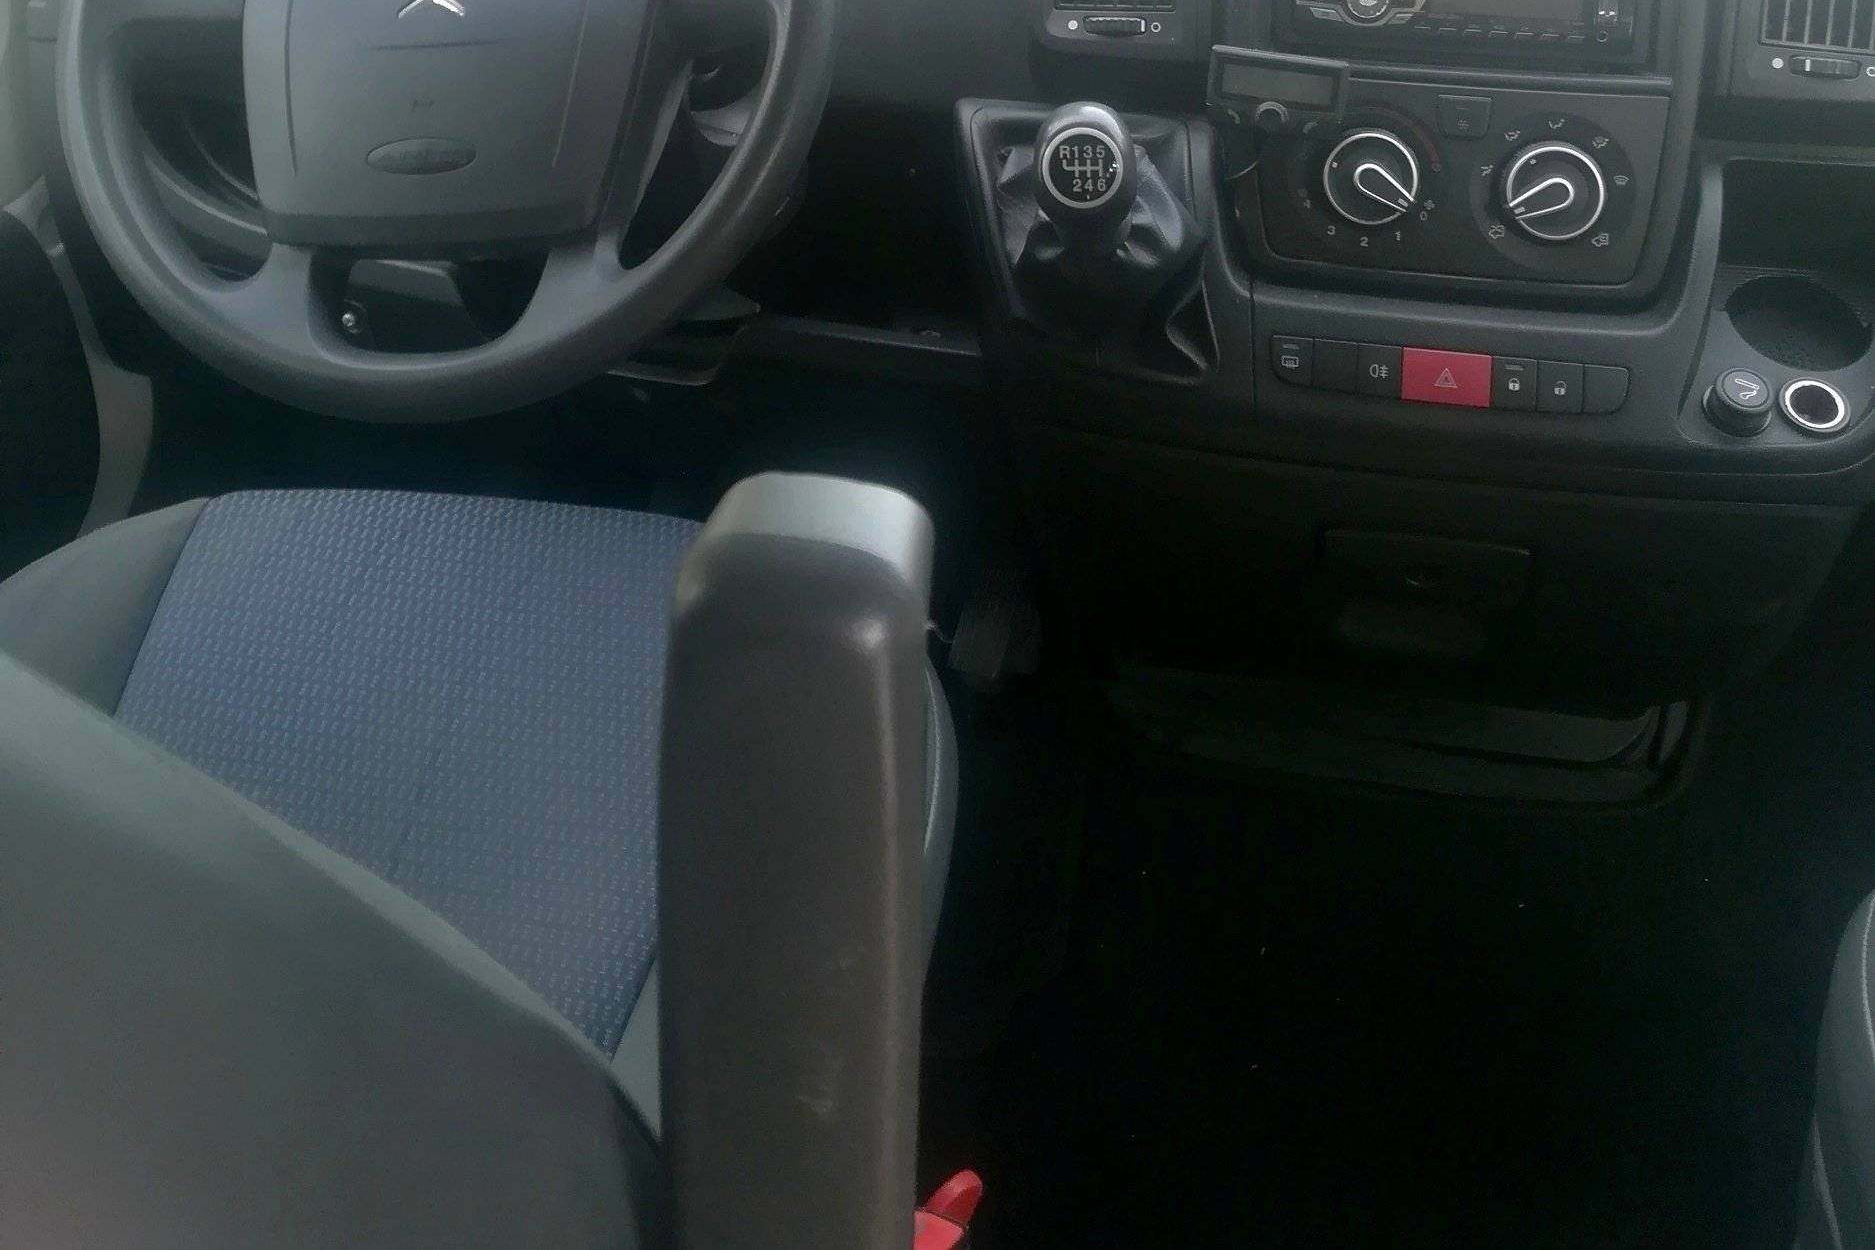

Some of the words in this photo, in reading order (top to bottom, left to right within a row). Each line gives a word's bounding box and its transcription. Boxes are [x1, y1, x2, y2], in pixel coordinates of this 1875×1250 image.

[1058, 145, 1070, 159] R
[1083, 145, 1093, 159] 3
[1095, 145, 1105, 159] 5
[1072, 178, 1082, 192] 2
[1084, 178, 1094, 192] 4
[1097, 177, 1107, 192] 6
[1326, 224, 1336, 236] 3
[1359, 235, 1369, 248] 2
